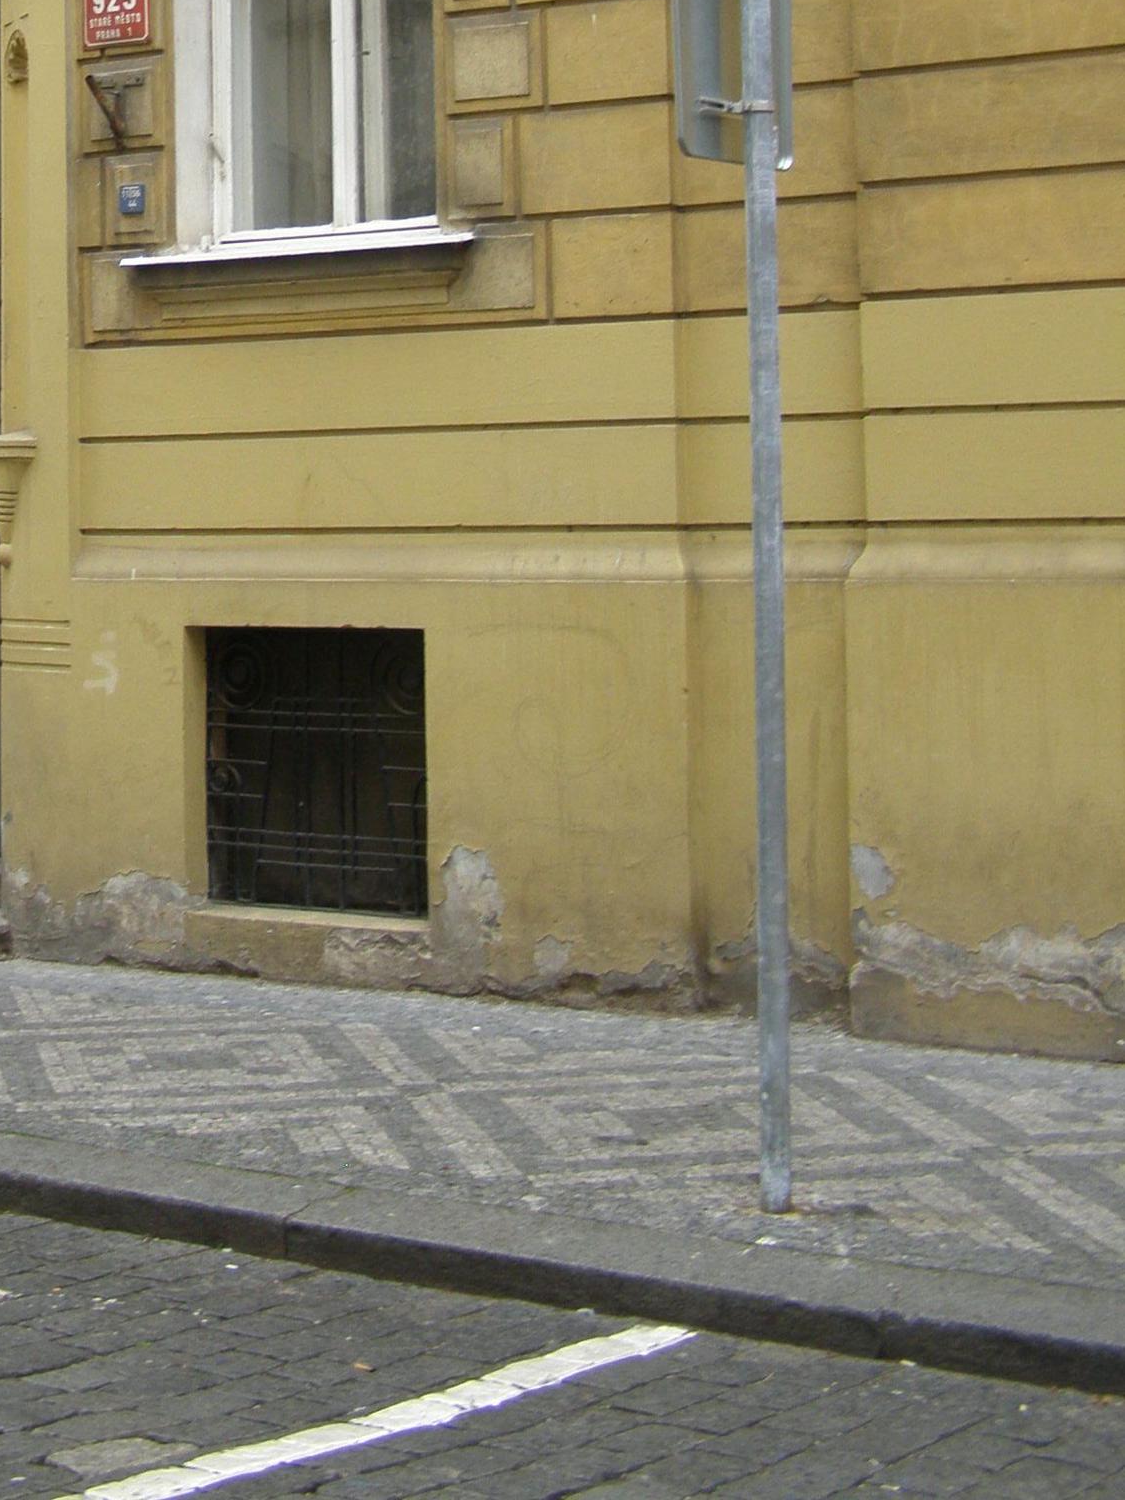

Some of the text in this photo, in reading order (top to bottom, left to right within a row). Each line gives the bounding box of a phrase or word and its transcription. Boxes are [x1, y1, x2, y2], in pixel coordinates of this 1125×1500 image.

[89, 12, 141, 28] STARÉ MĚSTO
[96, 27, 132, 40] PRAHA 1
